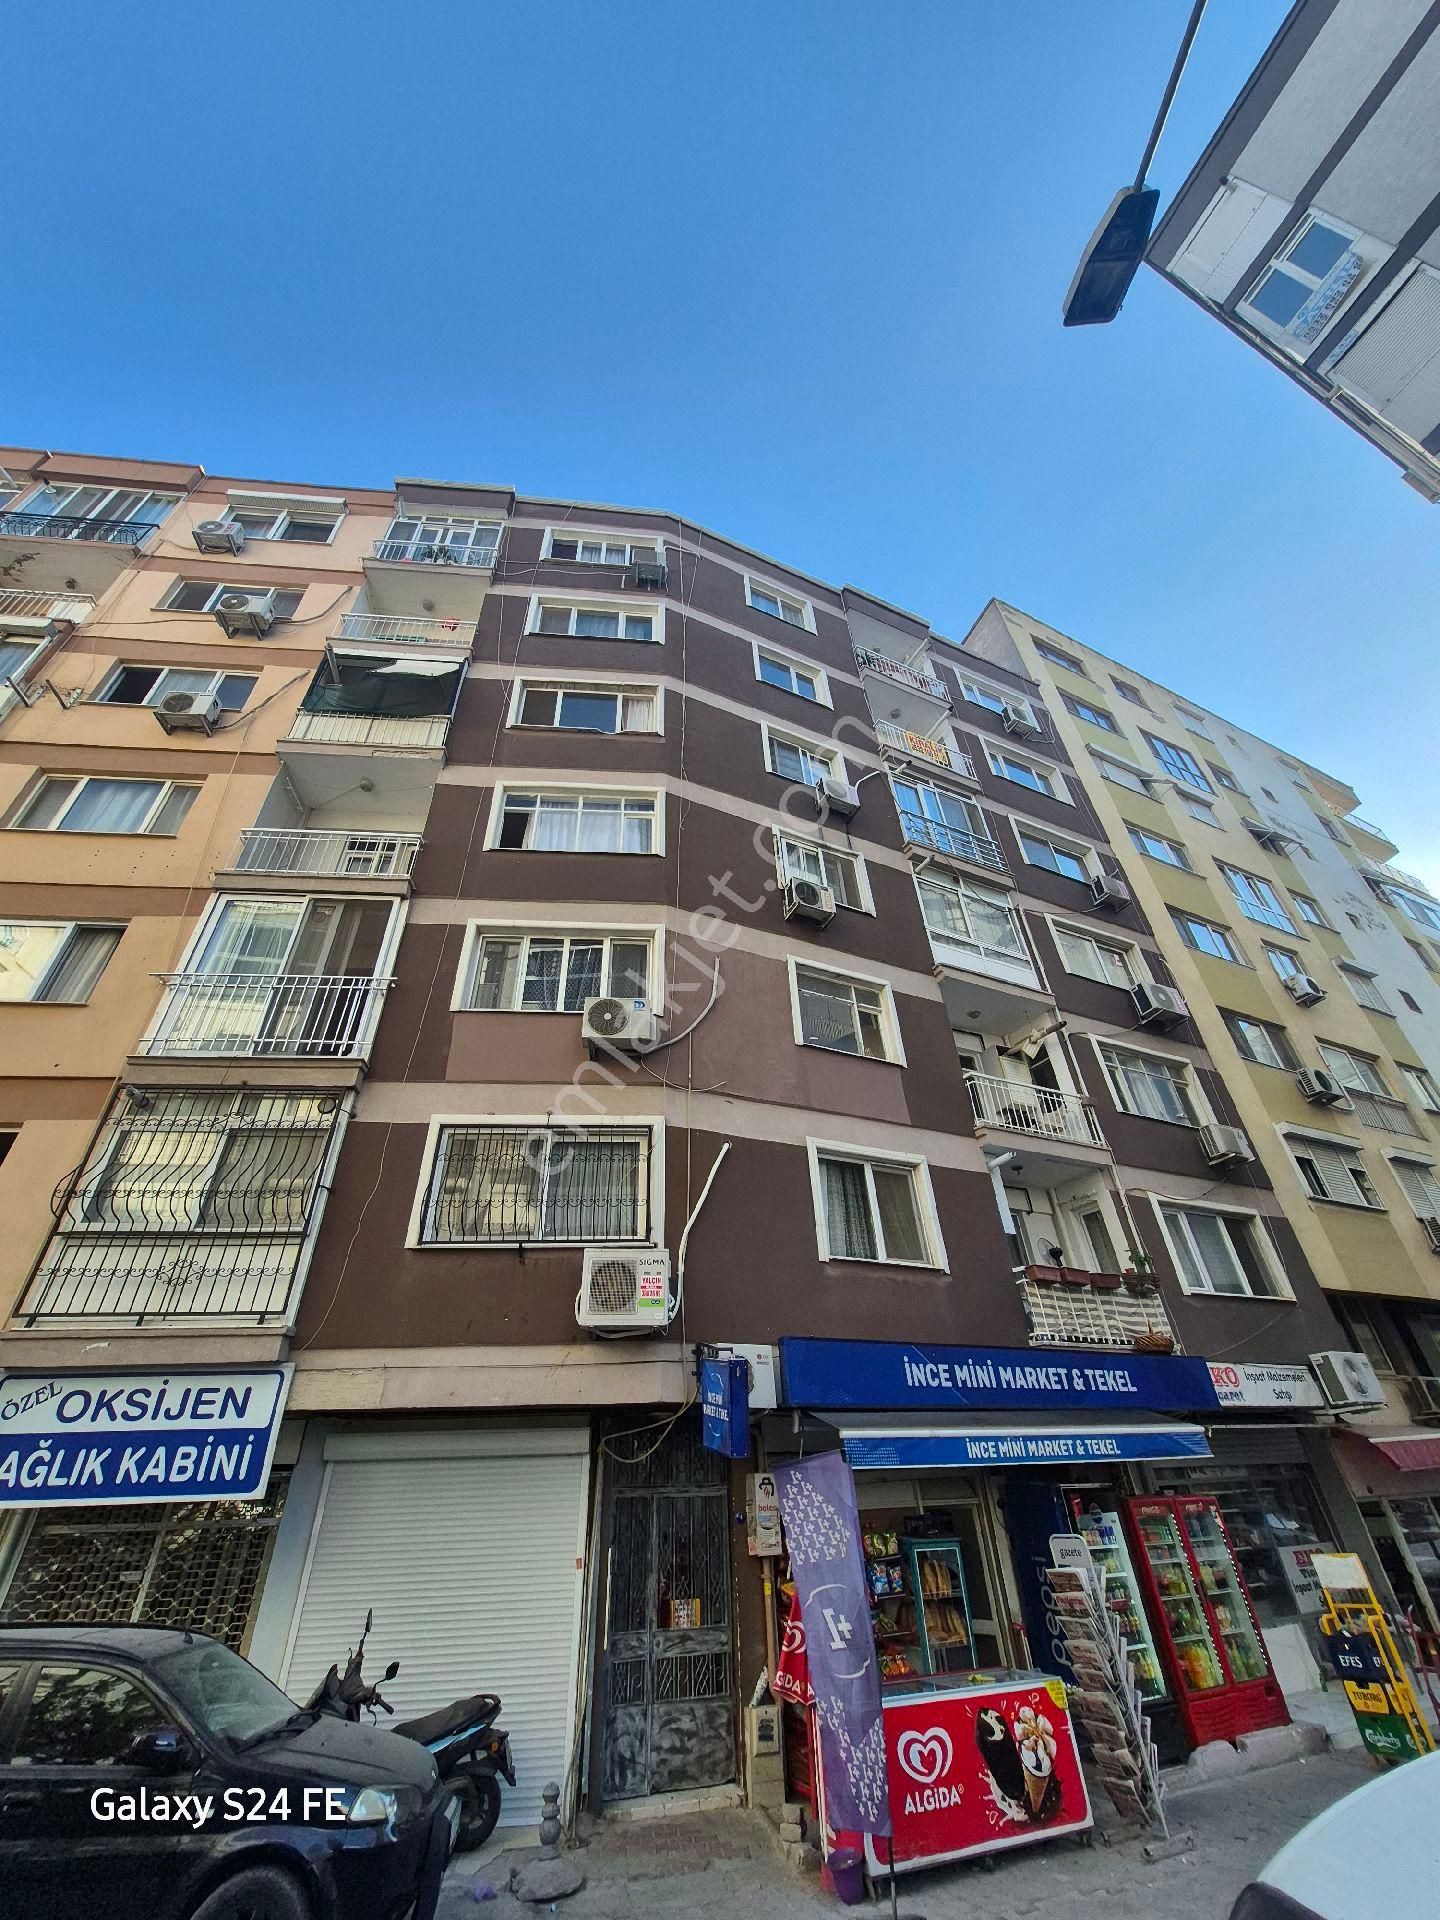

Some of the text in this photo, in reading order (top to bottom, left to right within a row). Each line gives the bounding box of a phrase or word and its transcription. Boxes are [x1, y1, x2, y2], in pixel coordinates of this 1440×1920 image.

[903, 1356, 1137, 1392] İNCE MİNİ MARKET & TEKEL
[1, 1381, 64, 1420] ÖZEL
[56, 1379, 252, 1423] OKSİJEN
[116, 1434, 255, 1484] KABİNİ
[966, 1437, 1121, 1459] İNCE MİNİ MARKET & TEKEL
[1338, 1655, 1363, 1669] EFES
[1352, 1691, 1383, 1703] TUBORG
